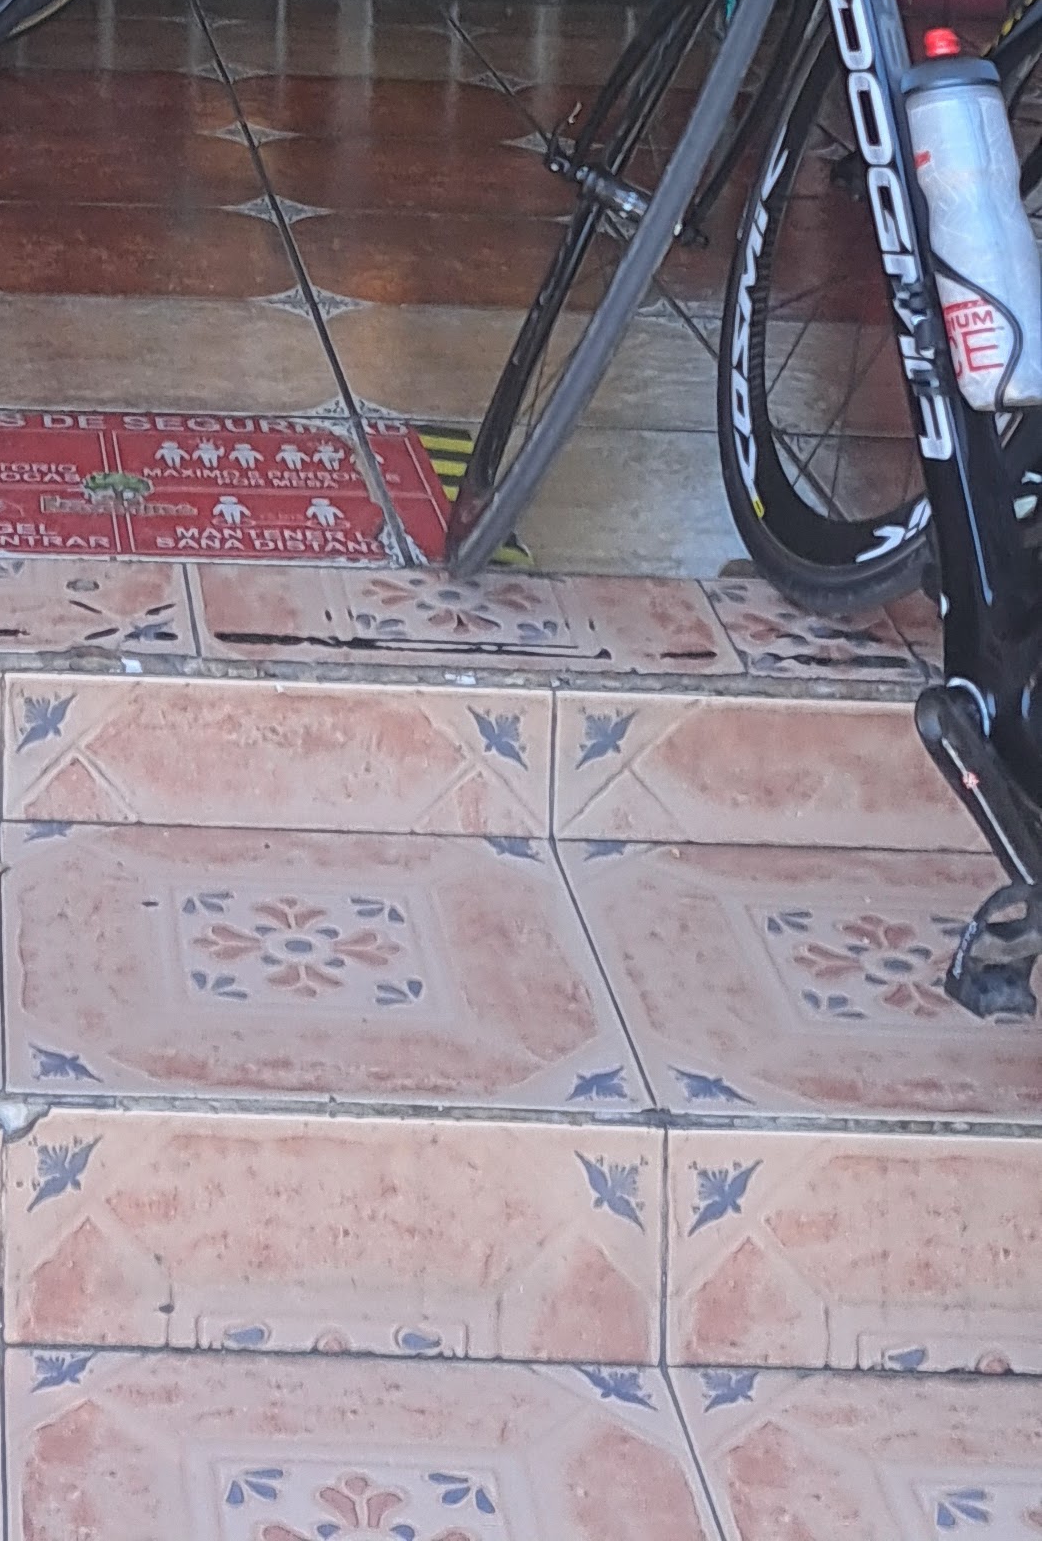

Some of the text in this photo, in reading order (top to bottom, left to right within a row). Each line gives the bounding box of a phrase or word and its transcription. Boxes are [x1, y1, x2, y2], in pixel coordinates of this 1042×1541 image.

[42, 412, 108, 430] DE
[122, 414, 408, 436] SEGURD
[267, 470, 401, 485] PERSONS
[254, 538, 386, 554] DISTANC
